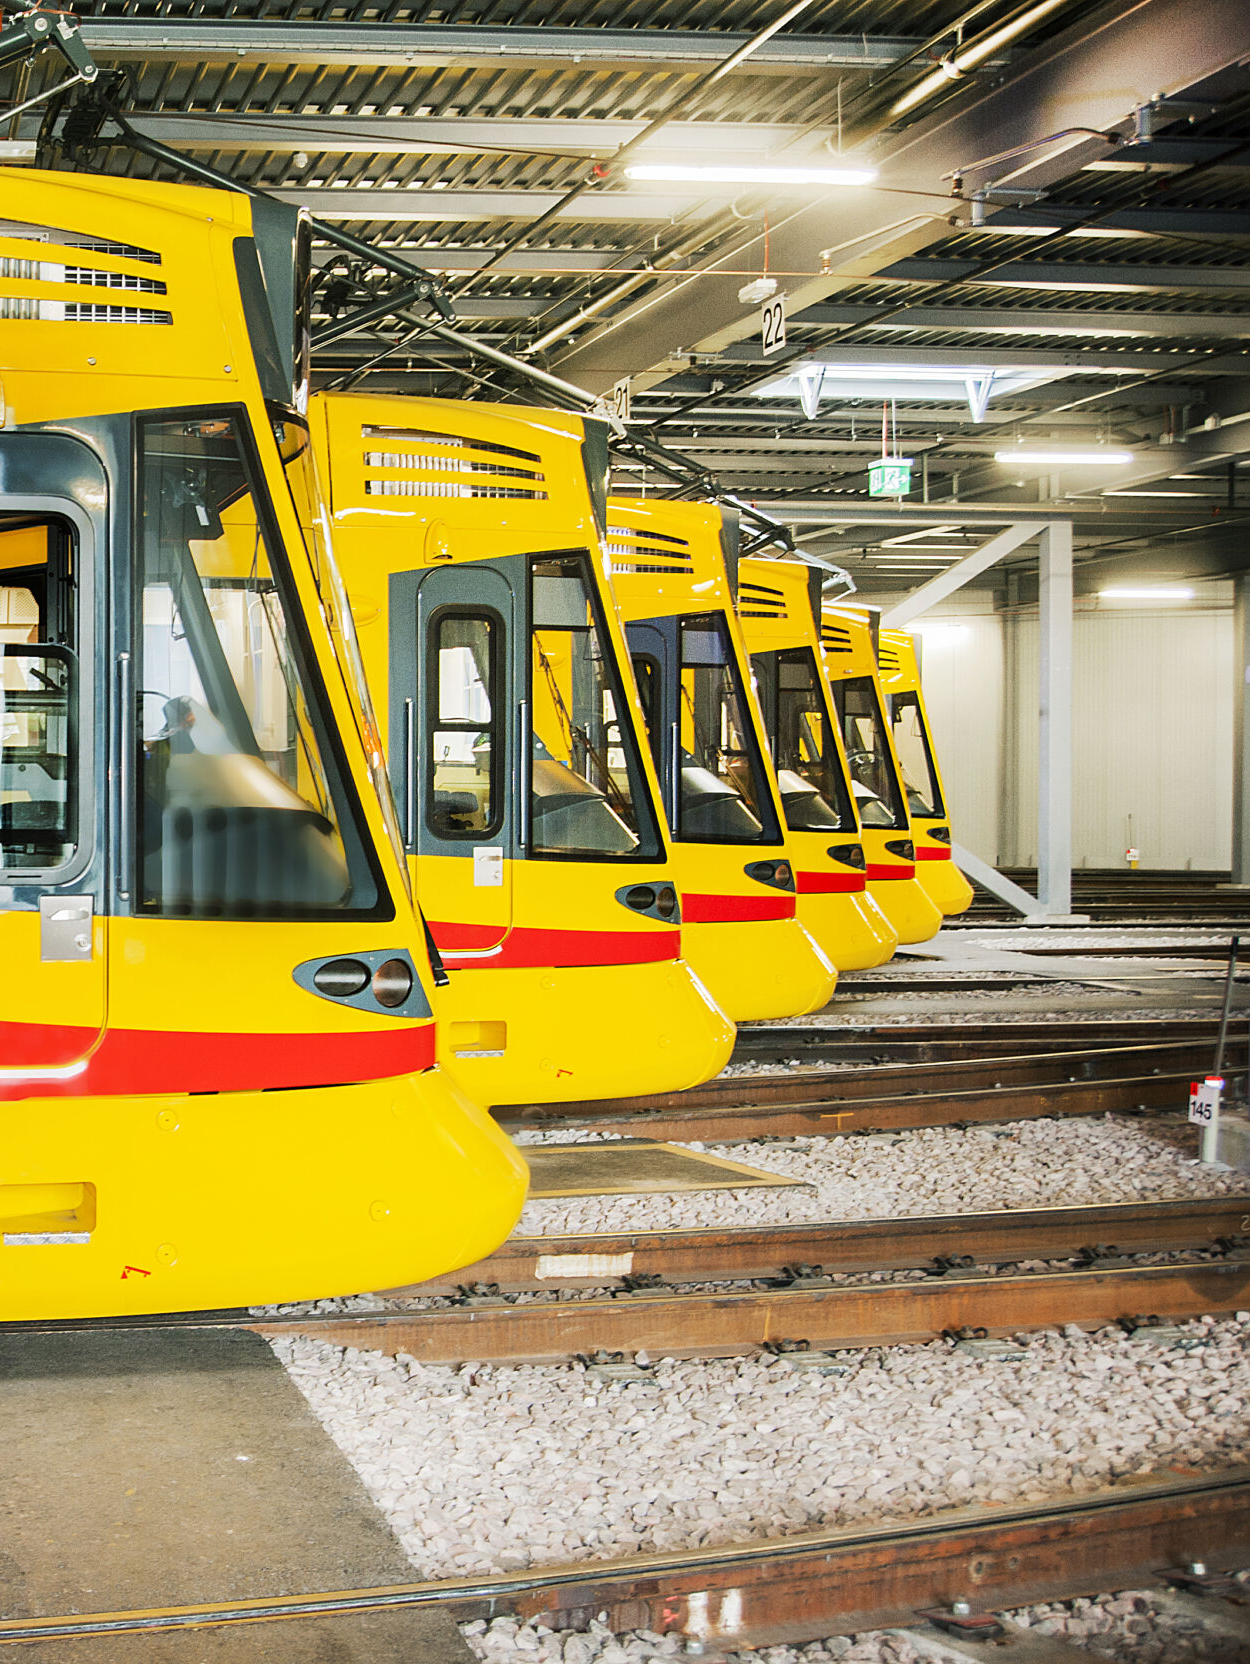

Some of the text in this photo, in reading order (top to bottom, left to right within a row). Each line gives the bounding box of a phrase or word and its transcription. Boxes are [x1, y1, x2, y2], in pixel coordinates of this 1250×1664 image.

[763, 302, 783, 349] 22
[615, 383, 628, 419] 21
[1190, 1100, 1212, 1120] 145
